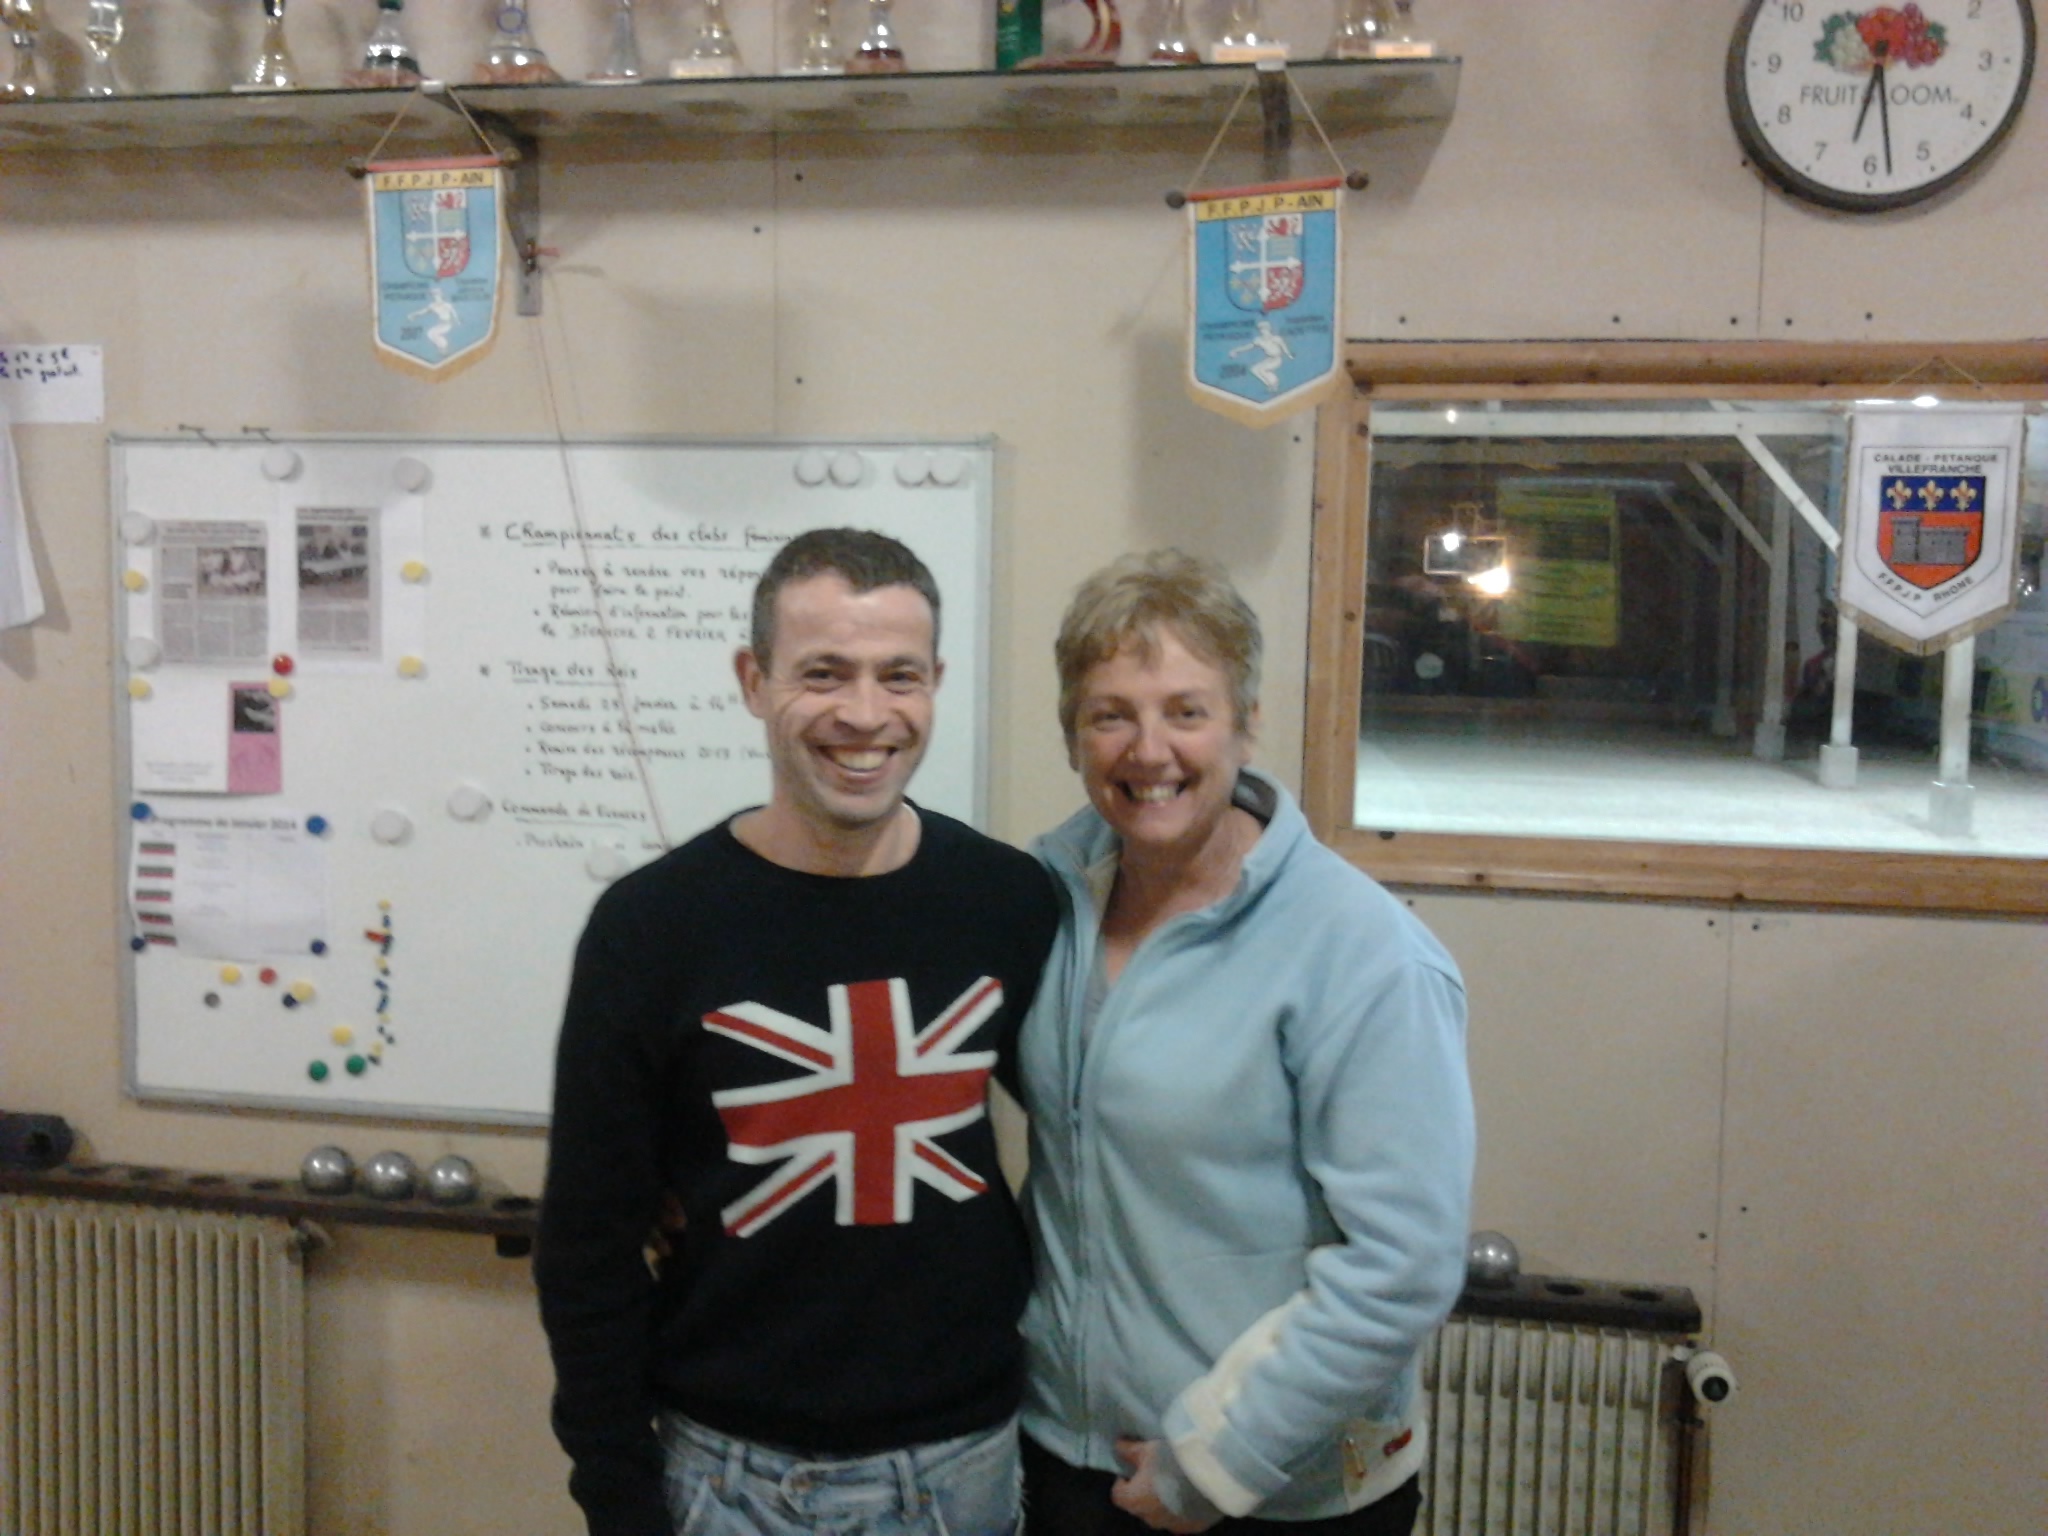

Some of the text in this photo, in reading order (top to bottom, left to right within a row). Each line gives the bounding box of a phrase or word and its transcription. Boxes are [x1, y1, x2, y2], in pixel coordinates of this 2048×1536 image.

[1782, 4, 1804, 22] 10
[1966, 0, 1982, 19] 2
[1767, 54, 1782, 74] 9
[1977, 52, 1993, 72] 3
[1800, 85, 1858, 105] FRUIT
[1777, 104, 1792, 125] 8
[1959, 103, 1974, 121] 4
[1814, 143, 1828, 162] 7
[1916, 141, 1931, 161] 5
[1863, 156, 1877, 176] 6
[1874, 454, 1921, 463] CALADE
[1934, 454, 1998, 463] PETANQUE
[1888, 464, 1982, 474] VILLEFRANCHE
[652, 524, 678, 541] des
